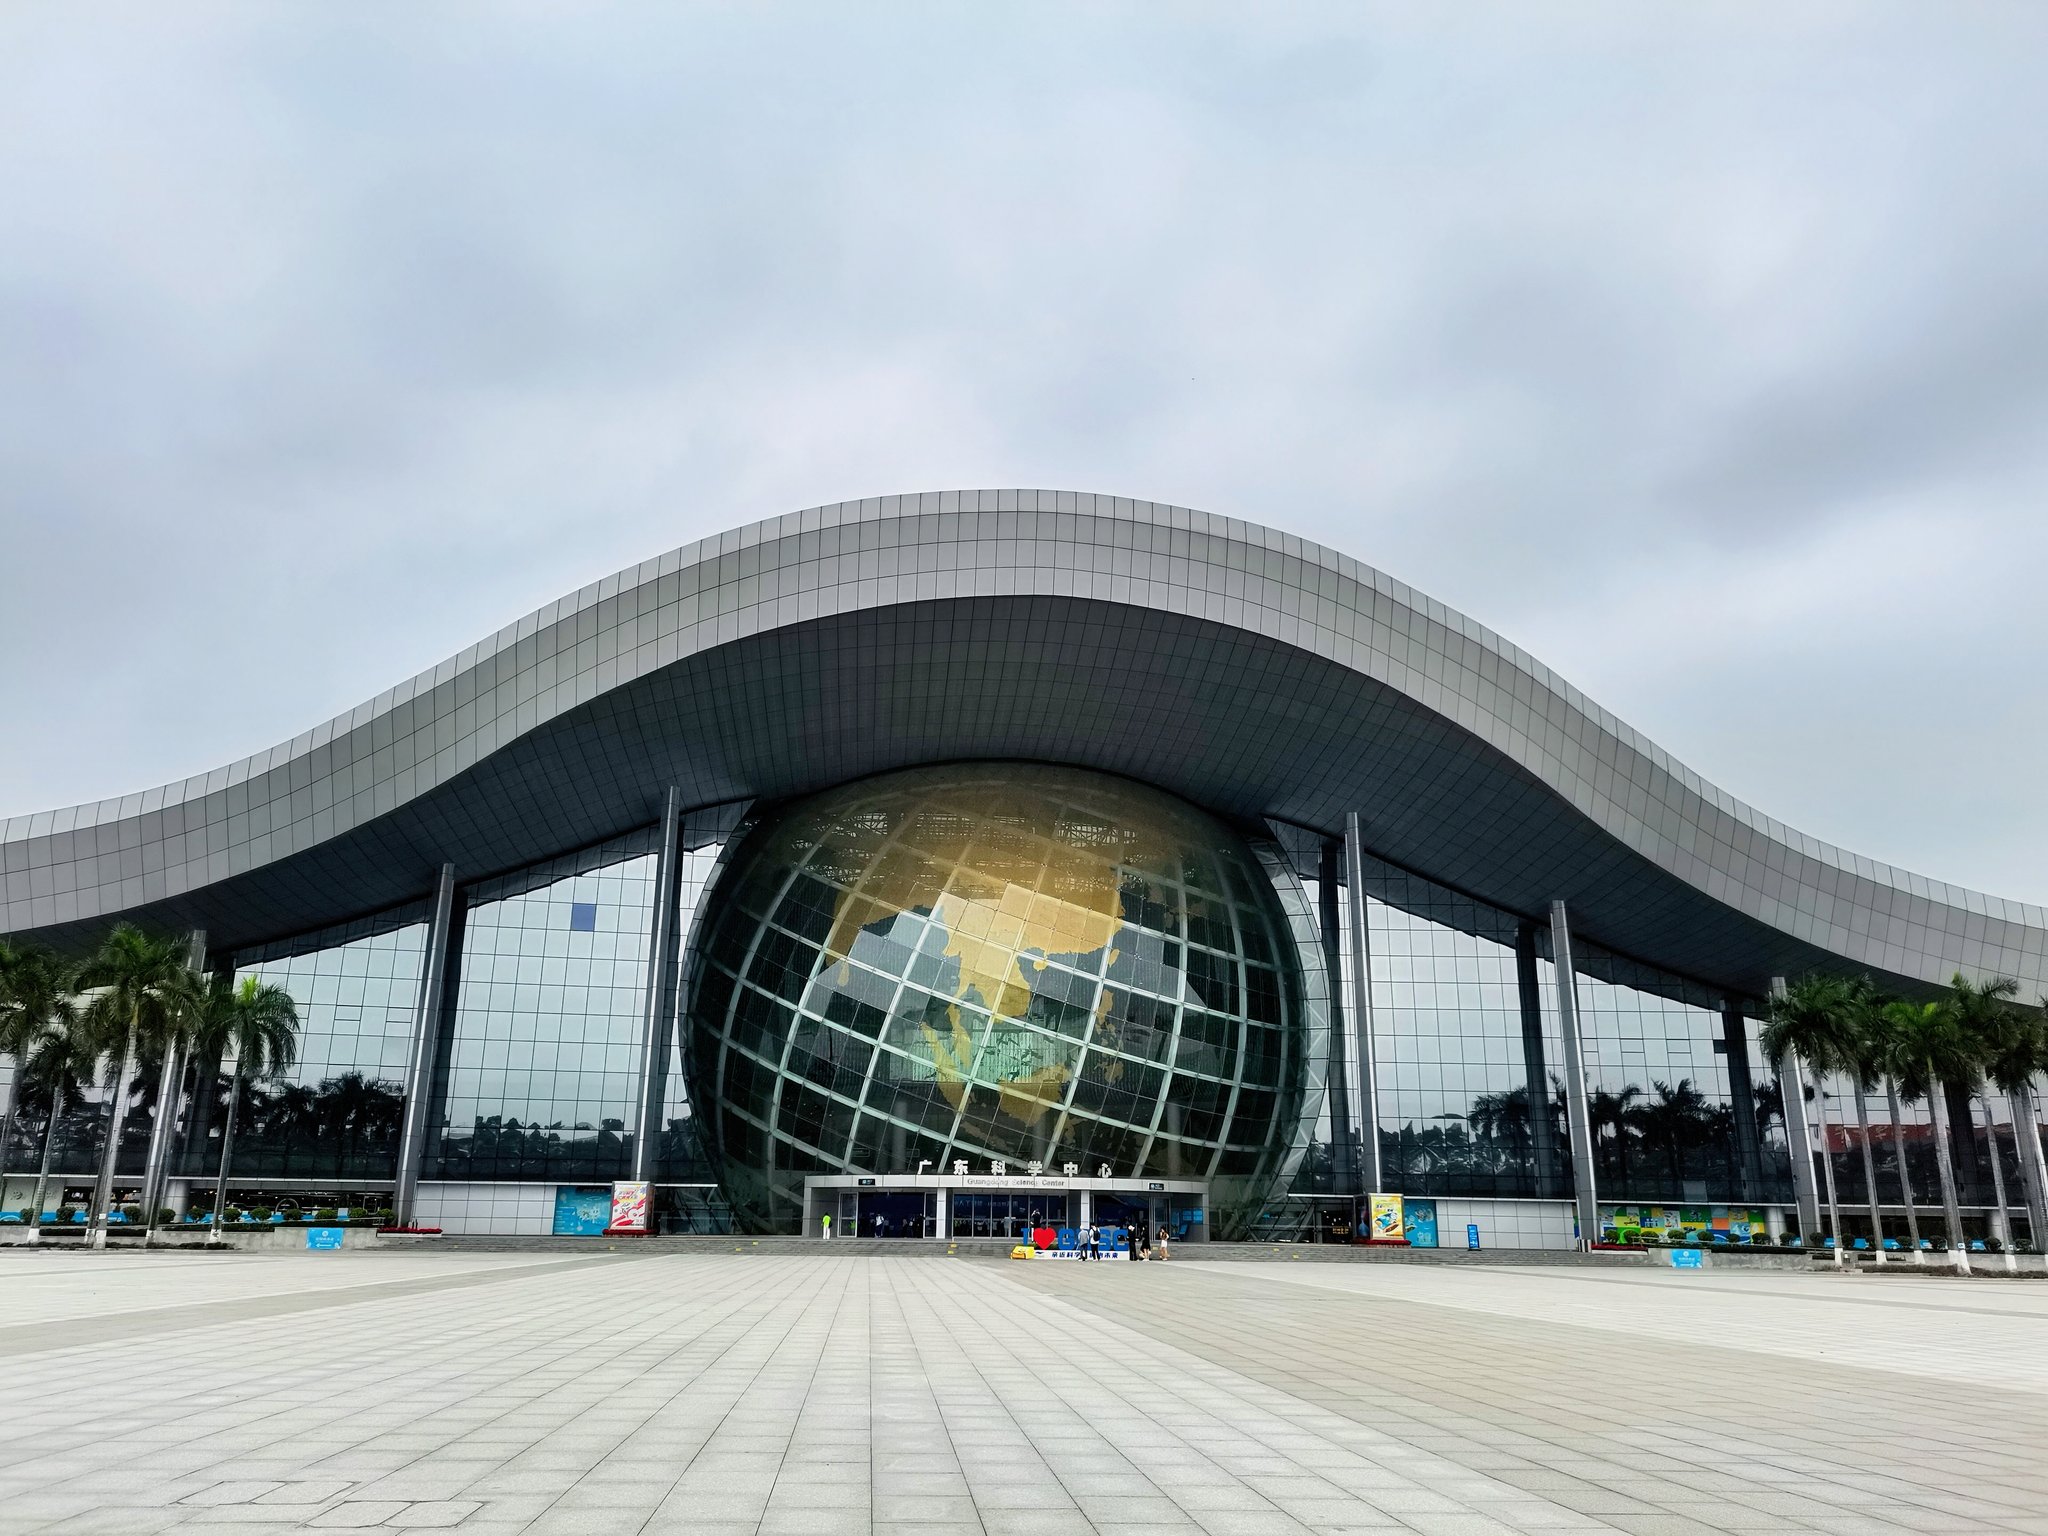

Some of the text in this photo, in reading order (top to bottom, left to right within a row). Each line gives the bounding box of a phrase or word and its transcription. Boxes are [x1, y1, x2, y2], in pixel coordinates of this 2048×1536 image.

[917, 1159, 1112, 1178] 广东科学中心
[1042, 1179, 1065, 1187] Center
[1058, 1227, 1129, 1251] GSC
